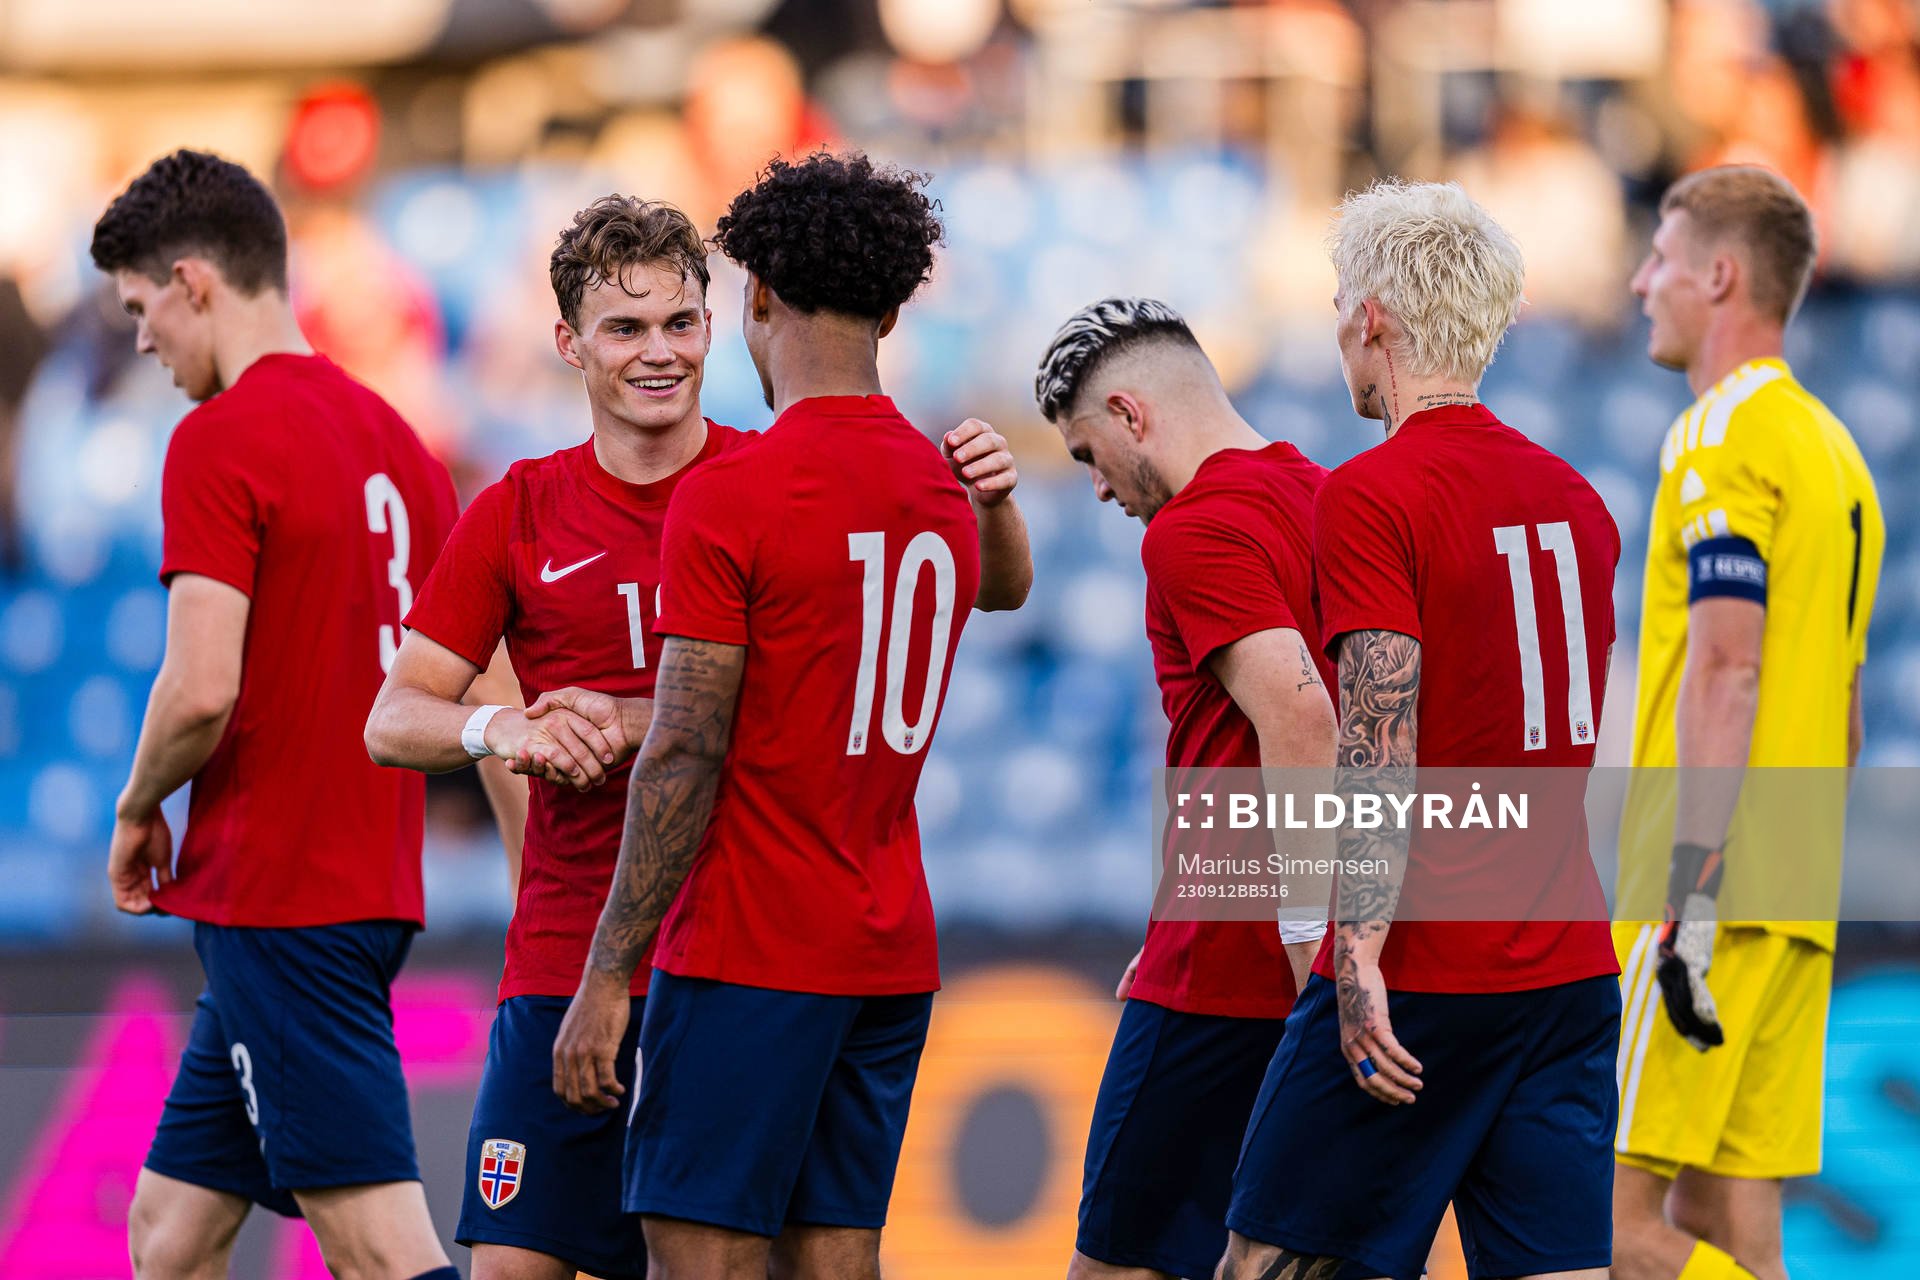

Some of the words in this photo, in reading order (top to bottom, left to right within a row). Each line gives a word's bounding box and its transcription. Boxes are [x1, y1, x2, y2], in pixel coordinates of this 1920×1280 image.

[364, 472, 413, 675] 3
[617, 582, 662, 669] 1
[846, 530, 957, 756] 10
[1492, 521, 1596, 751] 11
[230, 1042, 259, 1126] 3
